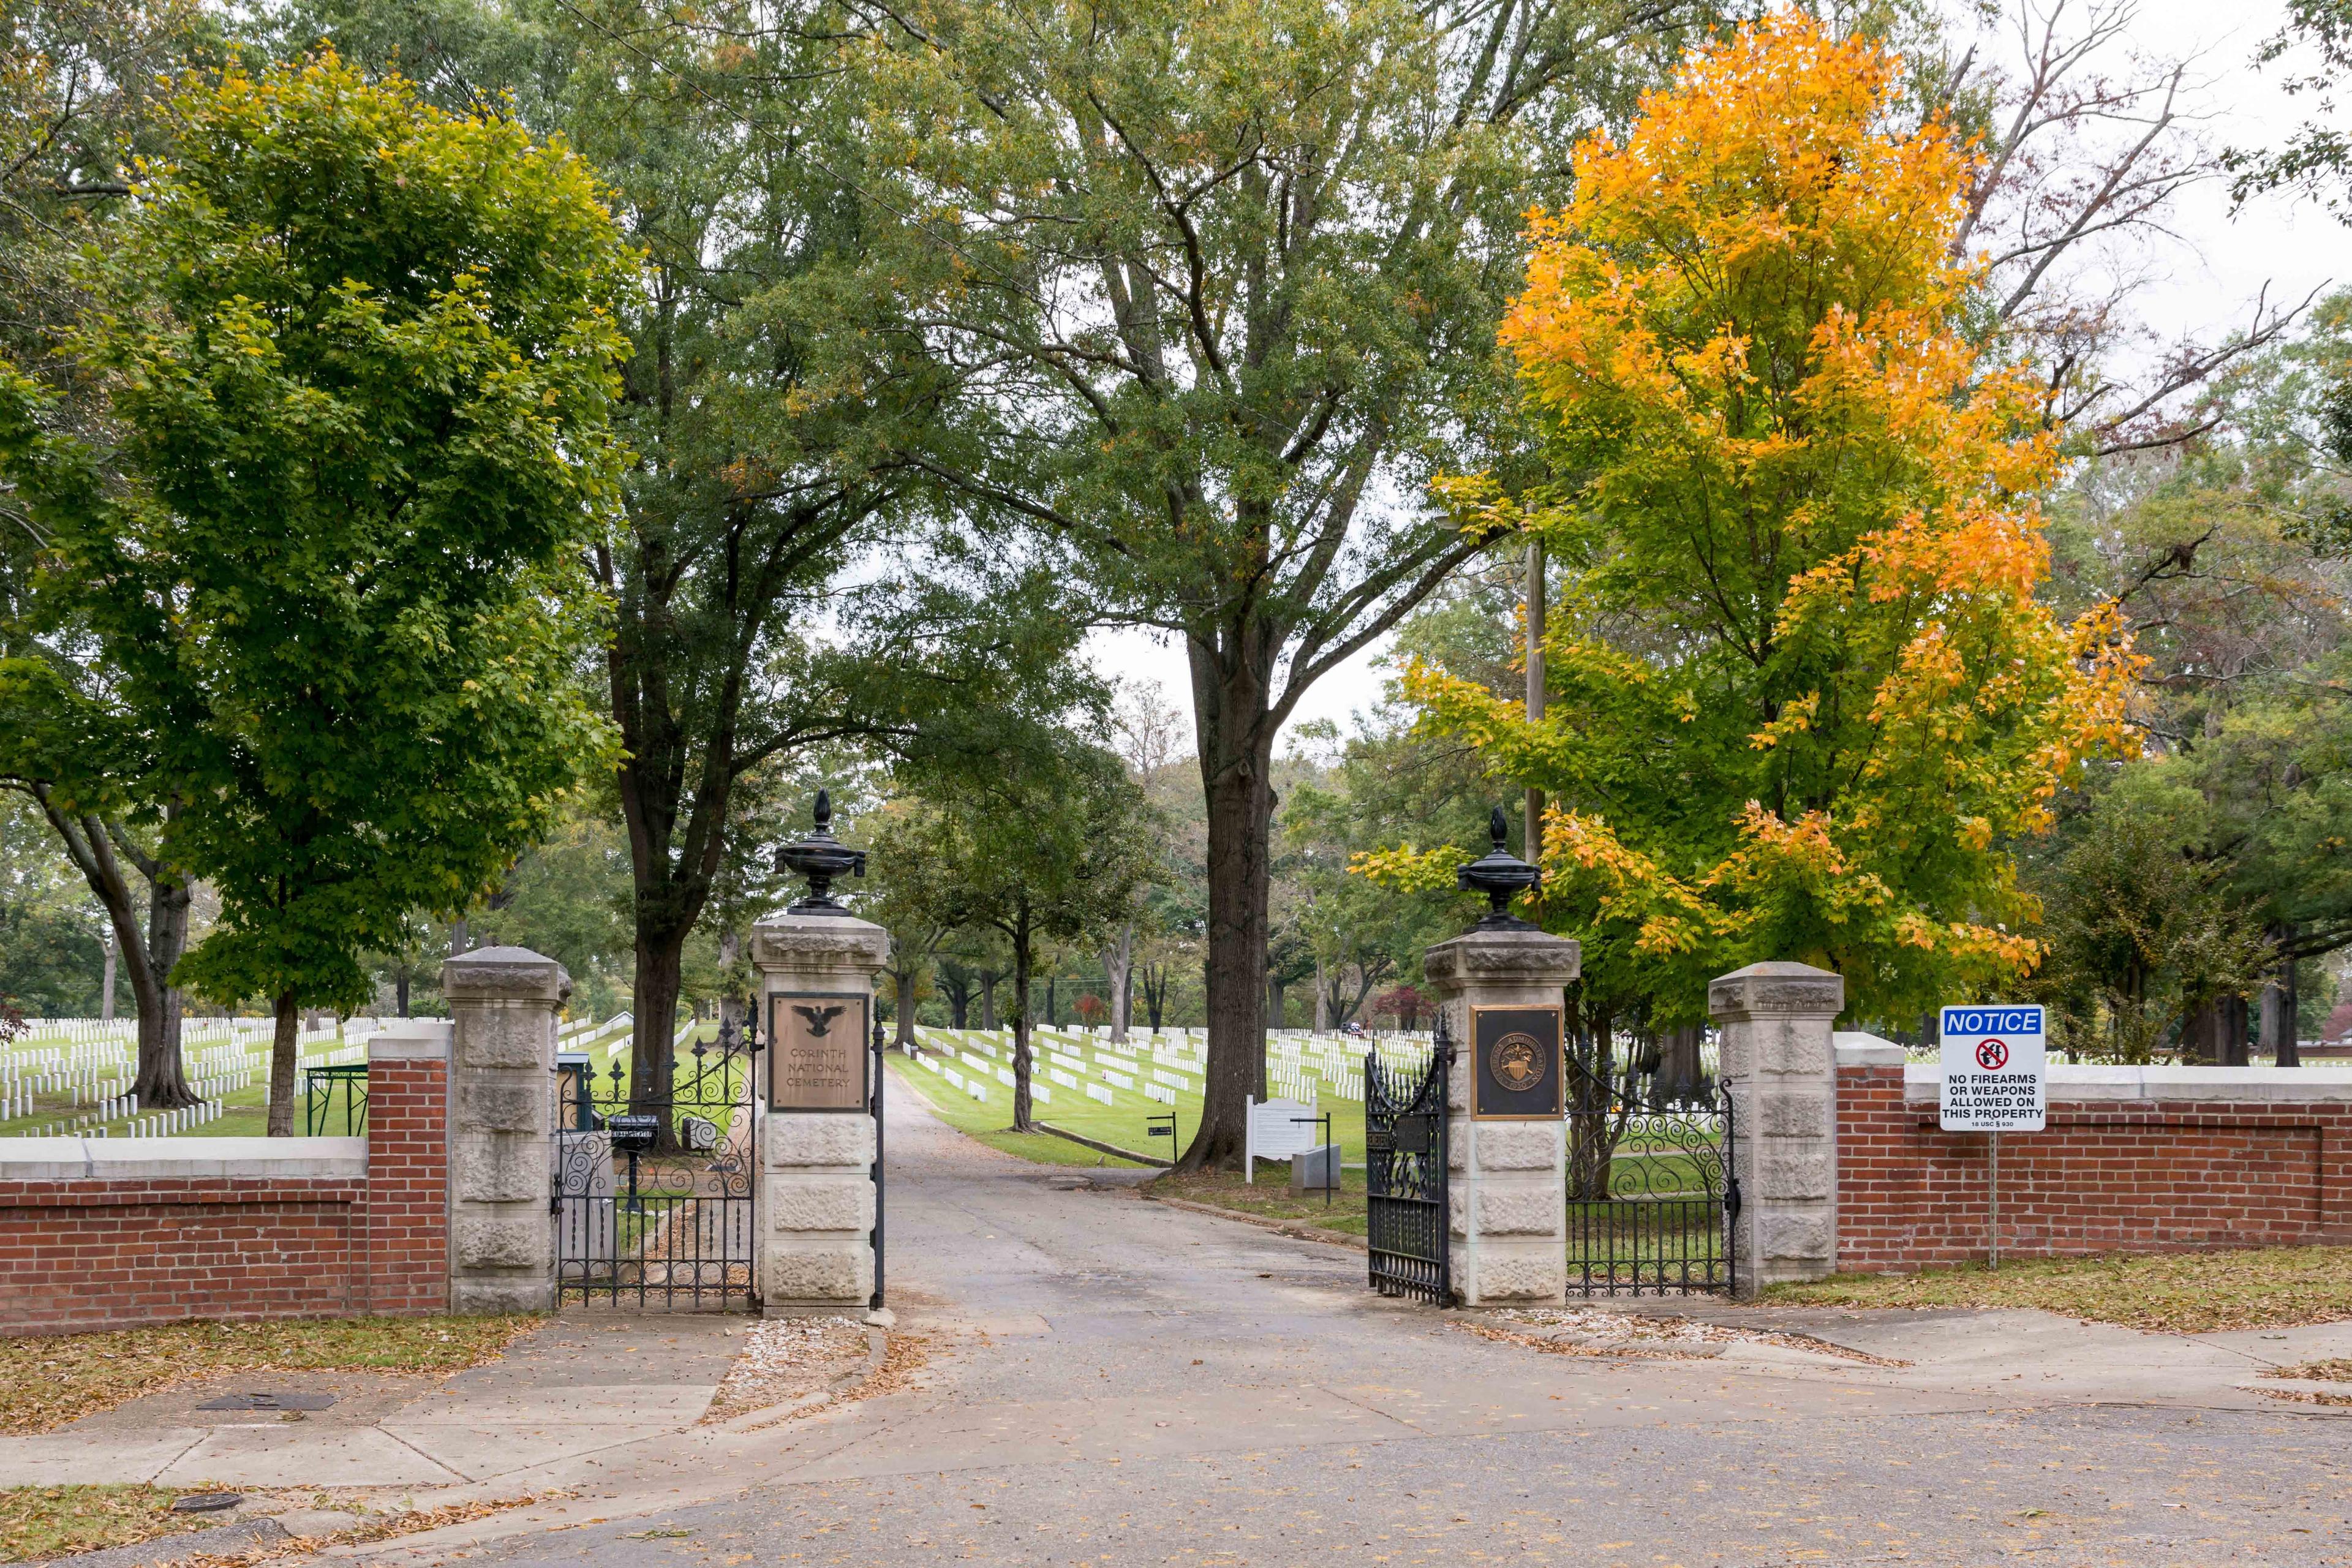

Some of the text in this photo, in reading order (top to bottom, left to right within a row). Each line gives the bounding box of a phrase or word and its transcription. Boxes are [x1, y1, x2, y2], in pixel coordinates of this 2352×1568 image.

[1947, 1012, 2039, 1032] NOTICE
[790, 1048, 846, 1058] CORINTH
[788, 1063, 849, 1073] NATIONAL
[786, 1077, 851, 1087] CEMETERY
[1949, 1074, 2037, 1084] NO FIREARMS
[1950, 1086, 2035, 1095] OR WEAPONS
[1950, 1098, 2035, 1107] ALLOWED ON
[1942, 1109, 2043, 1118] THIS PROPERTY
